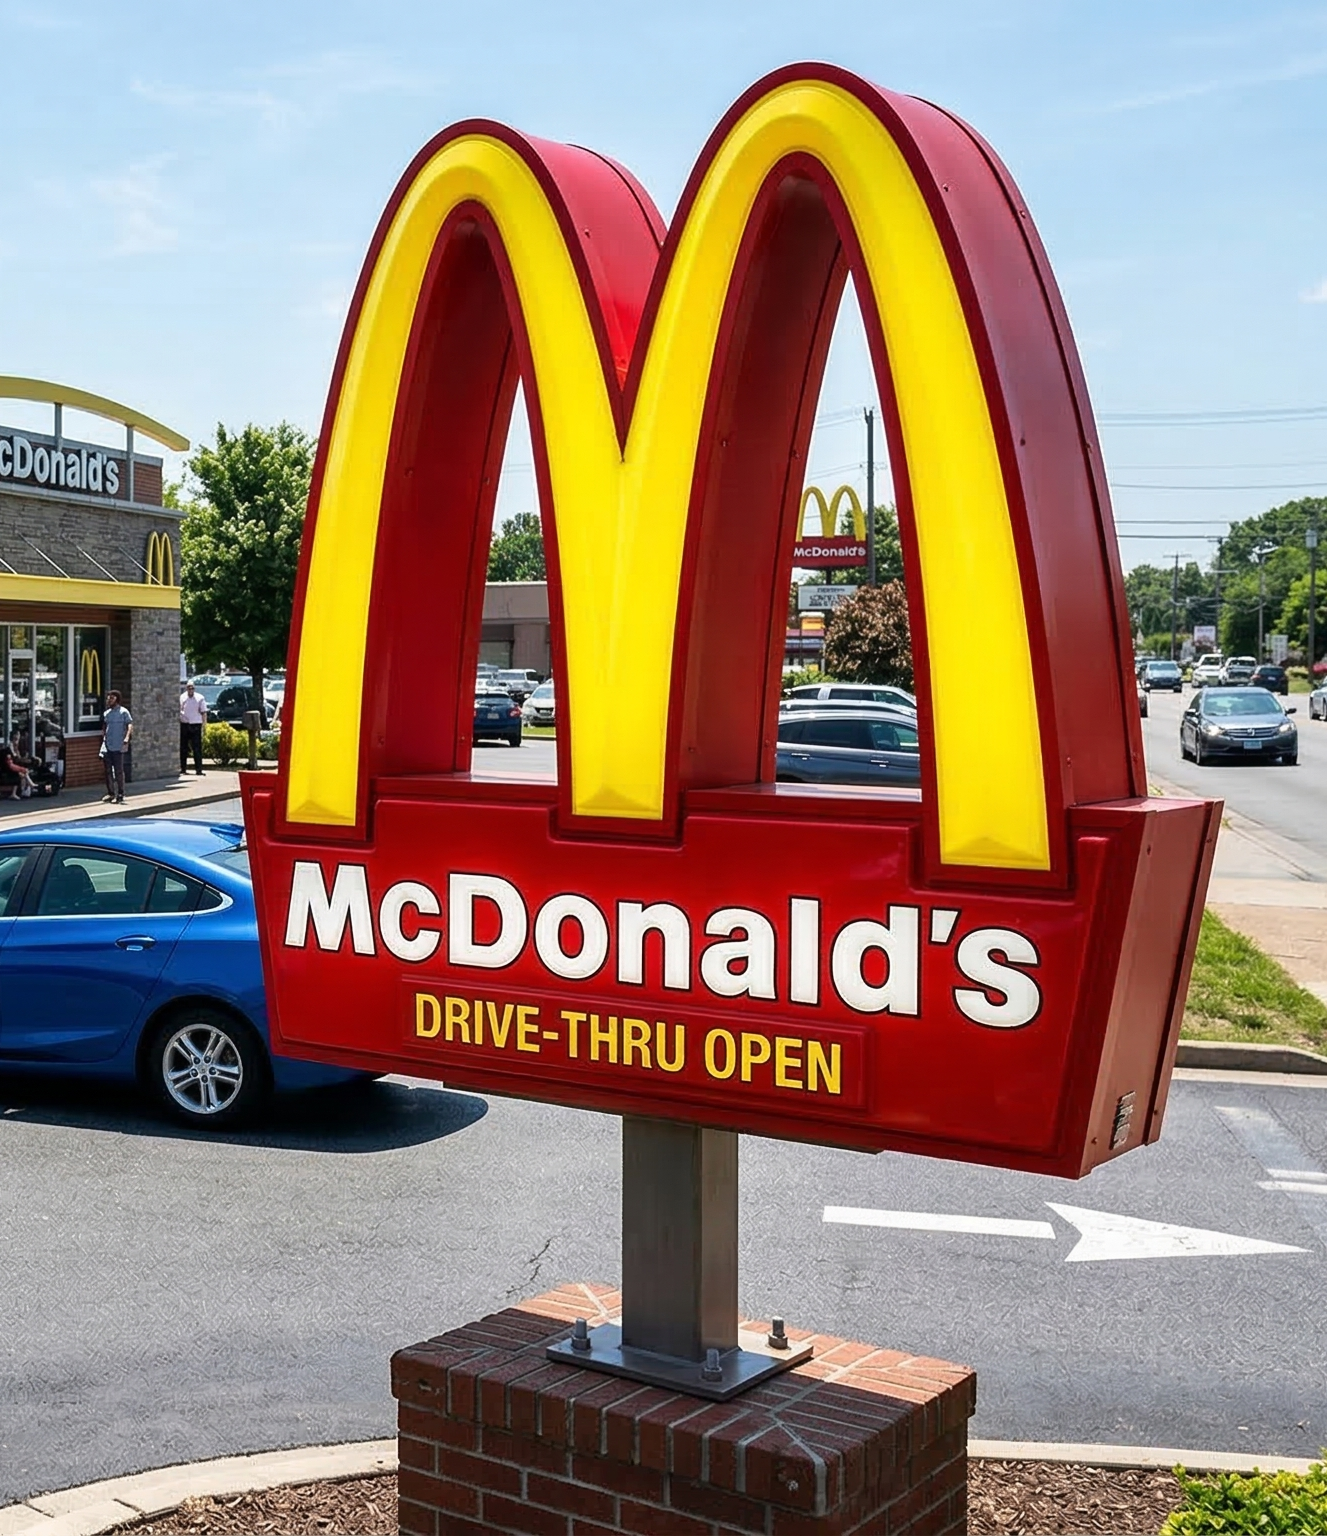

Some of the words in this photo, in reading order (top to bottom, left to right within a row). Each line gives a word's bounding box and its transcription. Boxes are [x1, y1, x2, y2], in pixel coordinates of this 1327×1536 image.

[283, 859, 1043, 1029] McDonald's
[414, 993, 686, 1073] DRIVE-THRU
[703, 1028, 842, 1095] OPEN
